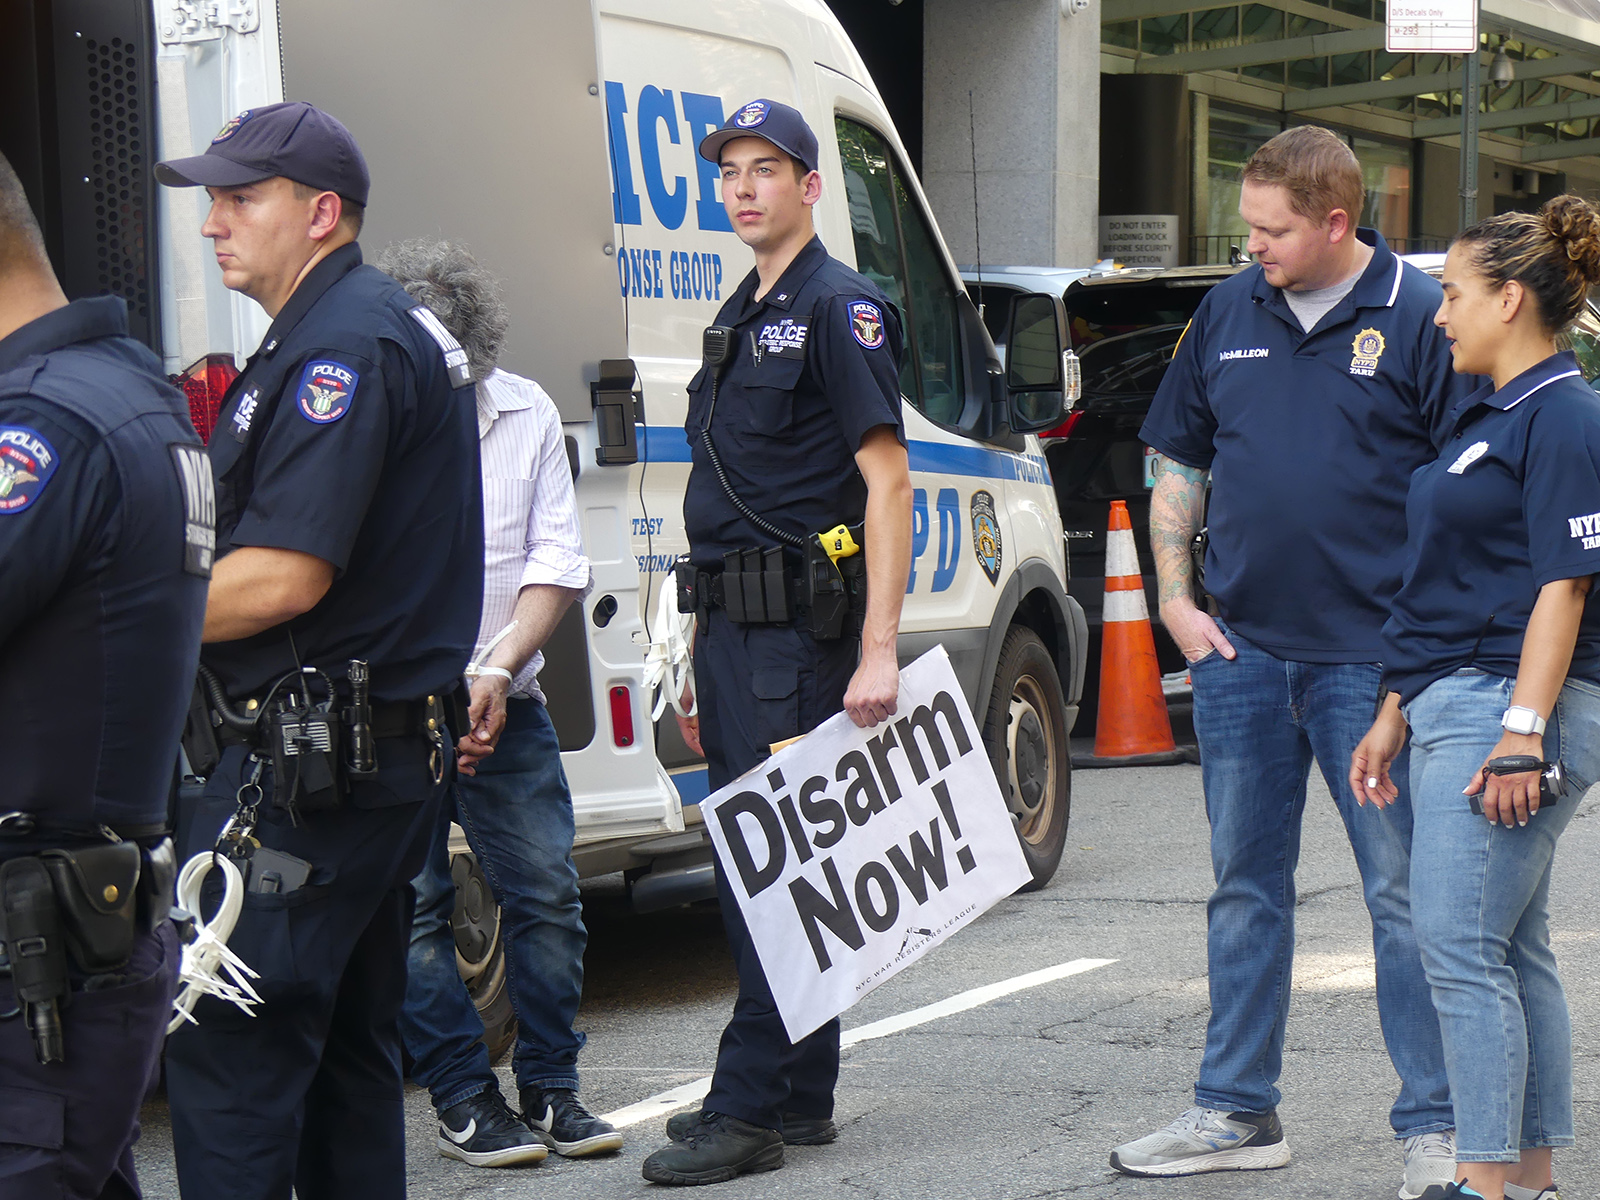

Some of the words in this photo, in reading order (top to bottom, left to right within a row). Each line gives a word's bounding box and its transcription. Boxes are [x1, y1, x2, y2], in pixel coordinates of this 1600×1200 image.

[1405, 8, 1427, 17] Decals
[1428, 8, 1444, 18] Only
[1109, 221, 1121, 230] DO
[1122, 221, 1139, 230] NOT
[1141, 221, 1167, 230] ENTER
[1108, 233, 1143, 241] LOADING
[1145, 233, 1168, 241] DOCK
[1102, 244, 1133, 253] BEFORE
[1135, 244, 1173, 253] SECURITY
[1114, 255, 1162, 264] INSPECTION
[670, 250, 722, 301] GROUP
[853, 303, 880, 318] POLICE
[759, 325, 808, 342] POLICE
[1219, 348, 1270, 362] McMILLEON
[312, 364, 353, 386] POLICE
[1349, 367, 1376, 377] TARU
[0, 430, 52, 469] POLICE
[714, 690, 973, 899] Disarm
[787, 778, 977, 974] Now!
[855, 976, 872, 992] NYC
[873, 962, 892, 978] WAR
[894, 928, 942, 964] RESISTERS
[943, 903, 977, 930] LEAGUE
